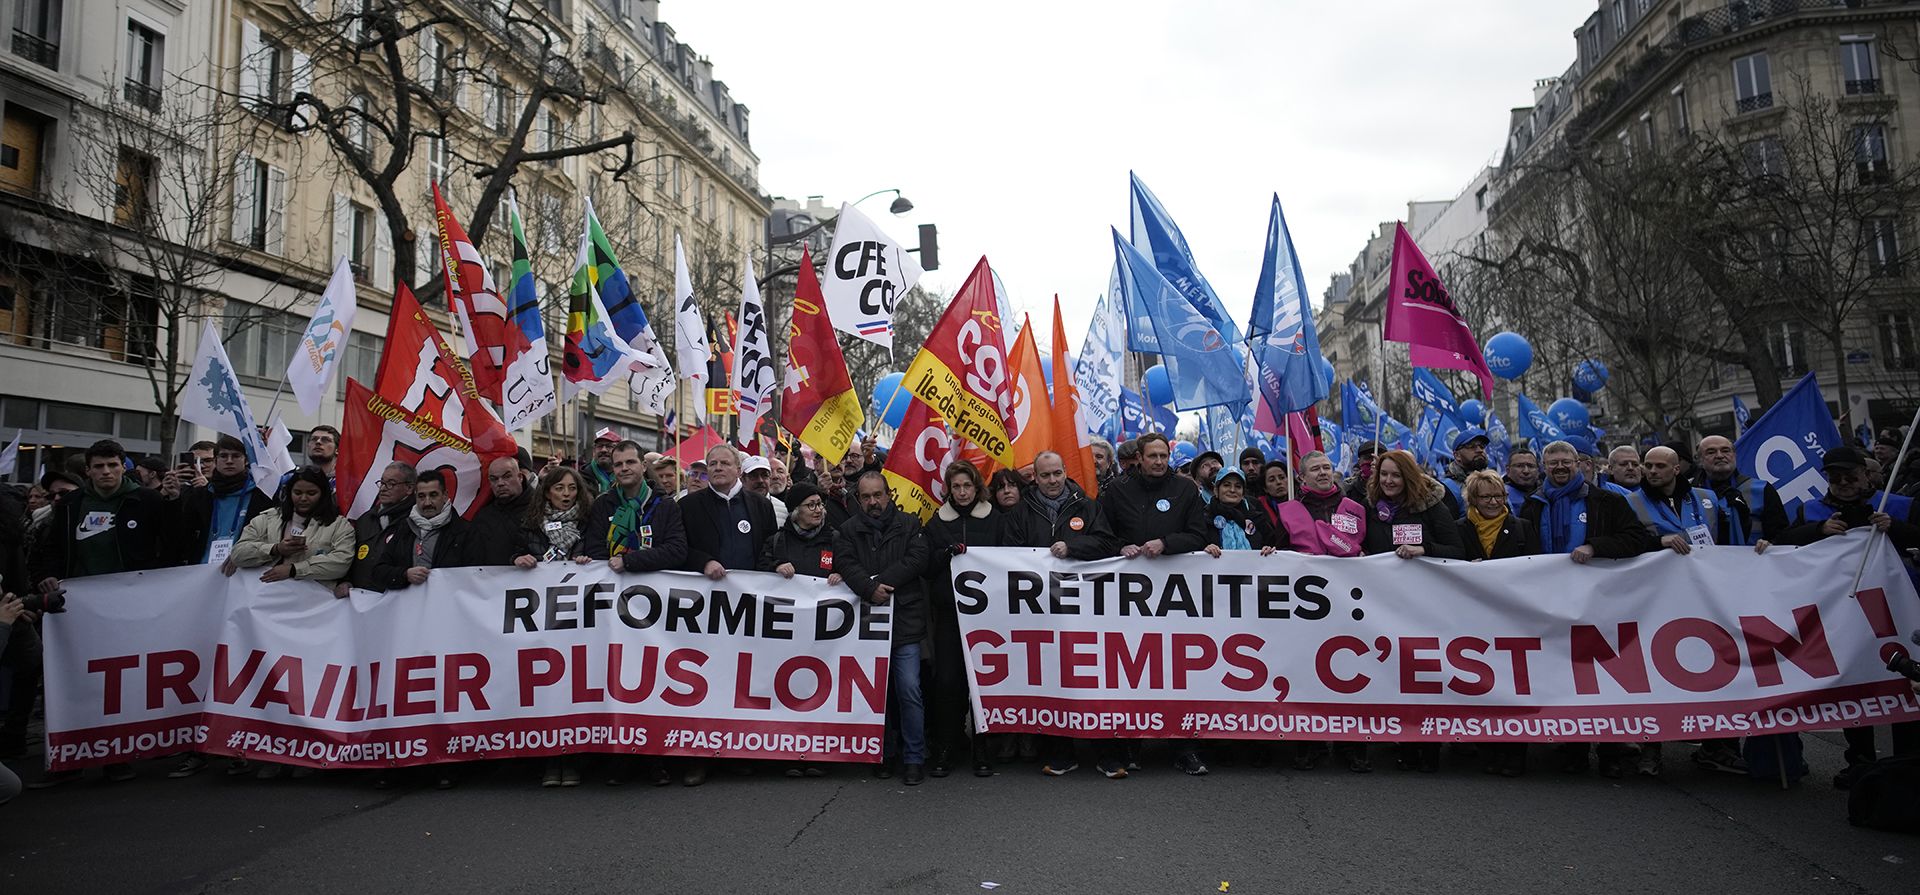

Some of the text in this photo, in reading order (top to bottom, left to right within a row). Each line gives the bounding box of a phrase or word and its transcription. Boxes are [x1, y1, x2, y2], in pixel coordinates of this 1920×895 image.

[834, 241, 888, 280] CFE
[956, 318, 1020, 423] cgt
[1487, 353, 1511, 368] cftc
[366, 393, 406, 424] Union
[914, 367, 1006, 457] Île-de-France
[1559, 419, 1583, 430] cftc
[820, 555, 833, 565] cgt
[502, 573, 891, 642] RÉFORME DE
[954, 570, 989, 616] S
[1008, 570, 1332, 621] RETRAITES
[965, 628, 1291, 704] GTEMPS,
[1569, 603, 1840, 696] NON
[87, 643, 888, 722] TRVAILLER PLUS LON
[982, 693, 1920, 737] PAS1JOURDEPLUS #PAS1JOURDEPLUS #PAS1JOURDEPLUS #PAS1JOURDEPL
[225, 729, 429, 763] #PAS1JOURDEPLUS
[446, 726, 648, 755] #PAS1JOURDEPLUS
[663, 728, 881, 756] #PAS1JOURDEPLUS
